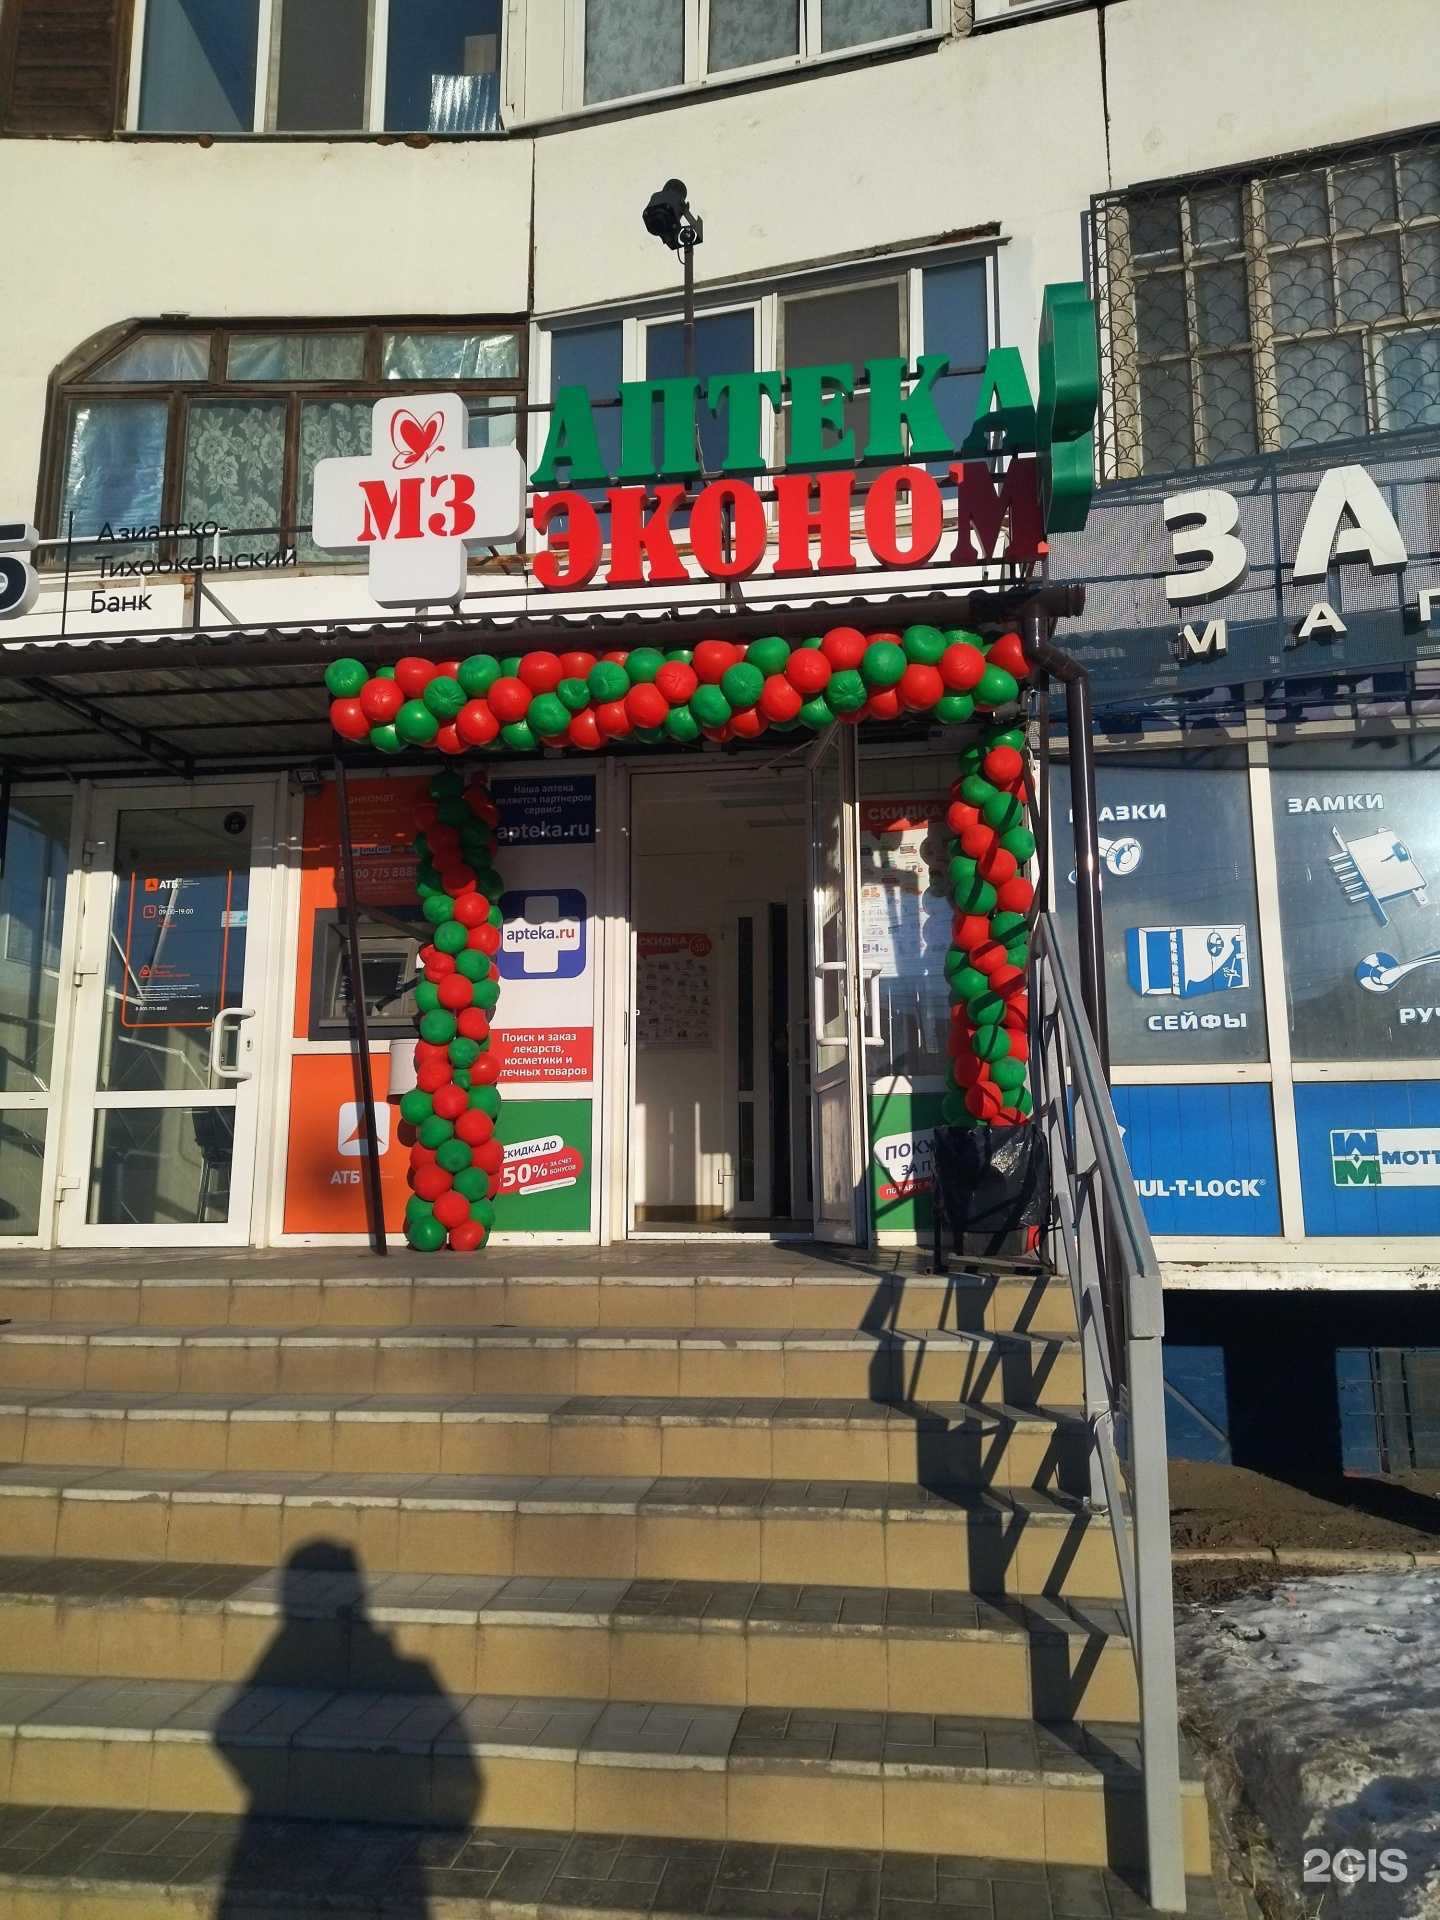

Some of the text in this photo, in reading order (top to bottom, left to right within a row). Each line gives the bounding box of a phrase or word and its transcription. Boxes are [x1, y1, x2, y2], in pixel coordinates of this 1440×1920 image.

[530, 346, 1038, 486] АПТЕКА
[96, 520, 230, 543] Азиатско-
[533, 455, 1049, 591] ЭКОНОМ
[95, 546, 298, 579] Тихоокеанский
[90, 590, 153, 614] Банк
[1069, 803, 1166, 823] АЗКИ
[1288, 793, 1385, 814] ЗАМКИ
[497, 820, 590, 842] apteka.ru
[506, 925, 575, 943] apteka.ru
[1148, 1012, 1248, 1031] СЕЙФЫ
[502, 1033, 535, 1042] Поиск
[548, 1033, 577, 1041] заказ
[512, 1045, 565, 1055] лекарств,
[504, 1056, 562, 1065] косметики
[543, 1067, 588, 1077] товаров
[543, 1140, 557, 1151] ДО
[330, 1170, 360, 1184] АТБ
